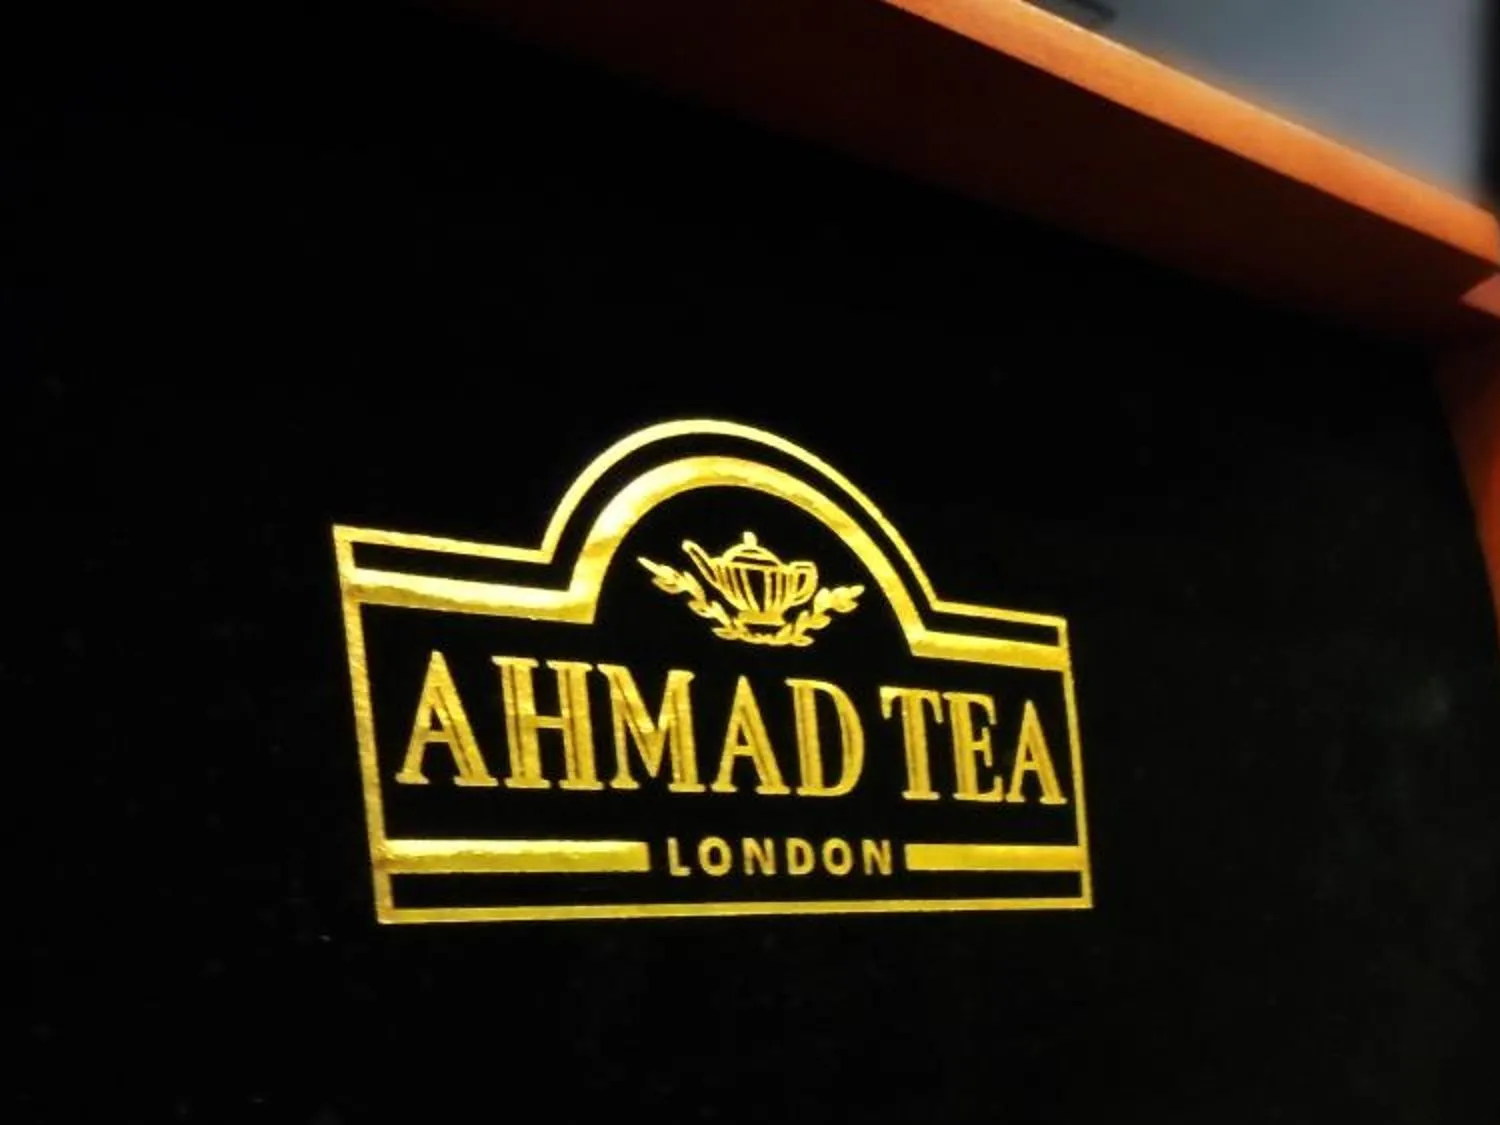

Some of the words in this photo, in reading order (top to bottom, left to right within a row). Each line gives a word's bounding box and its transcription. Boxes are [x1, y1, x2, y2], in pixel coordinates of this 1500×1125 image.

[396, 651, 865, 797] AHMAD
[879, 685, 1067, 804] TEA
[667, 837, 892, 877] LONDON
